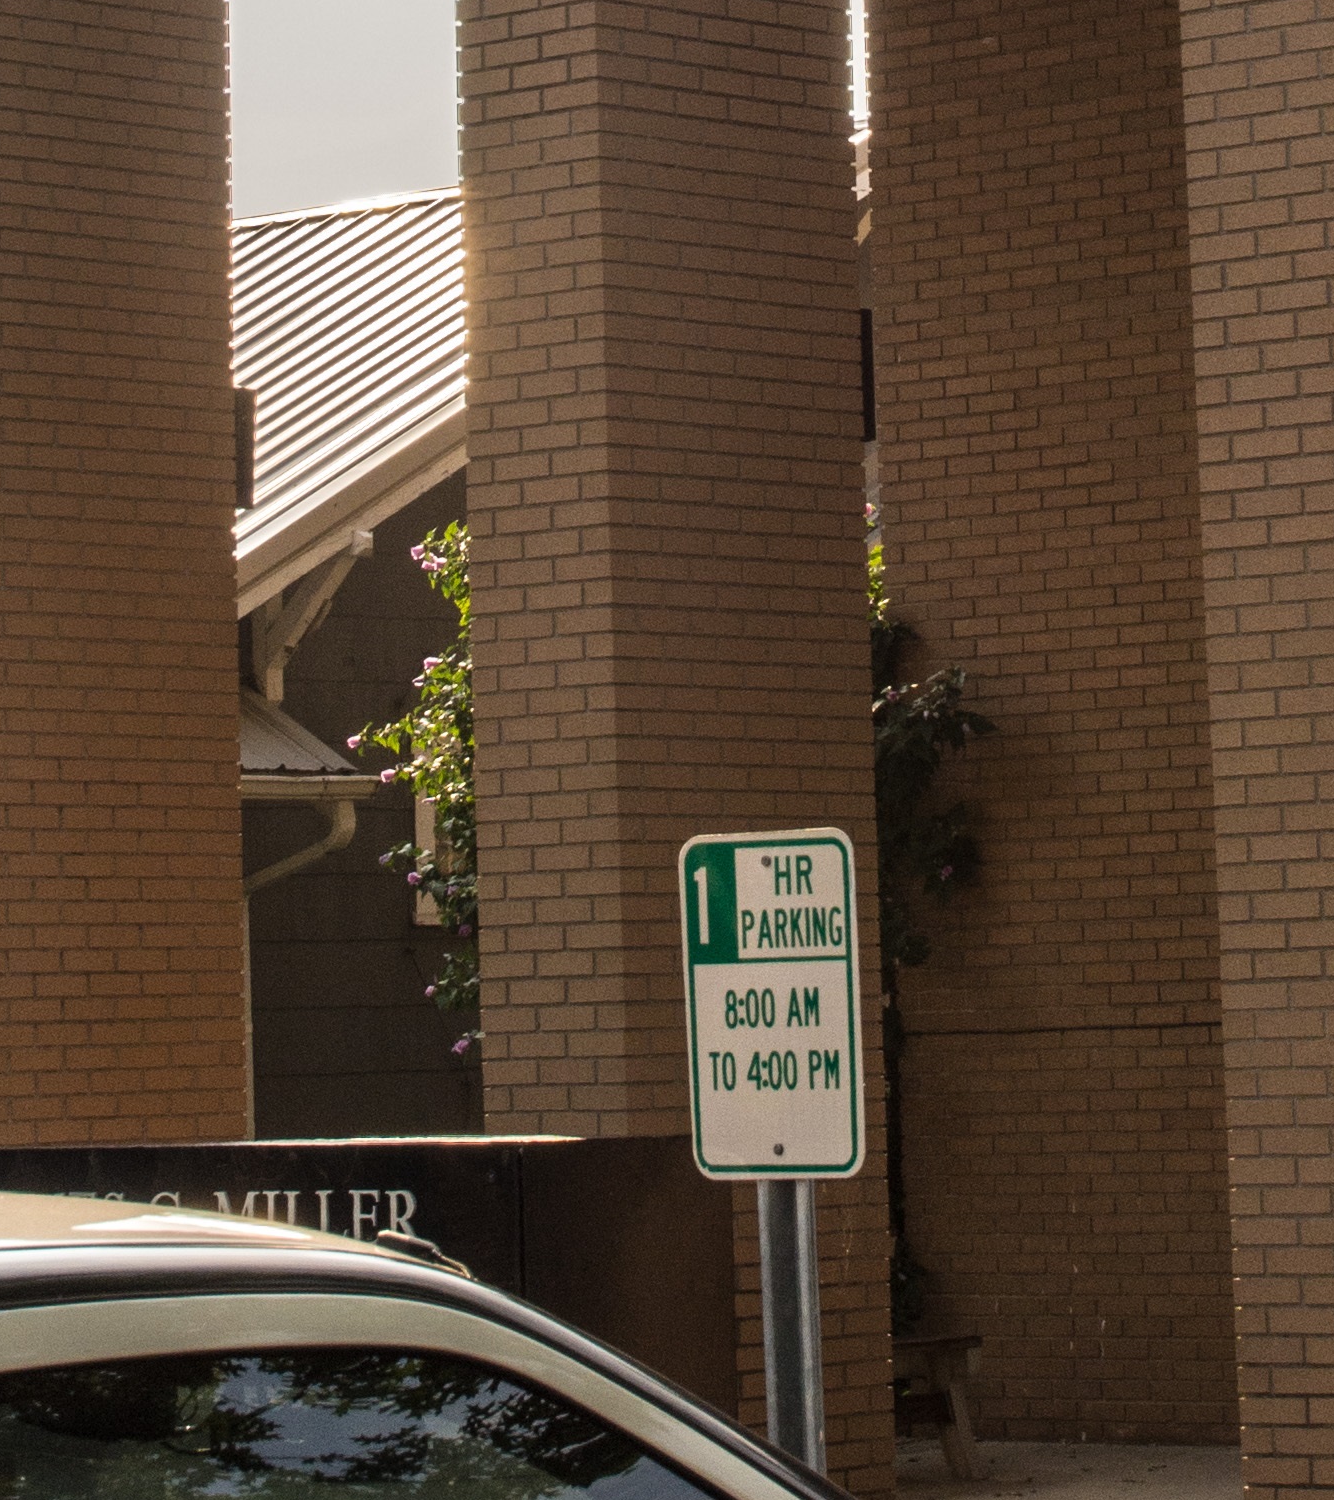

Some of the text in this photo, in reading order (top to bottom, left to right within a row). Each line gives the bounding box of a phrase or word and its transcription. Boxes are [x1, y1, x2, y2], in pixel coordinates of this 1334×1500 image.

[693, 854, 814, 946] 1 HR
[741, 906, 843, 949] PARKING
[725, 987, 820, 1029] 8:00 AM
[709, 1049, 841, 1091] TO 4:00 PM
